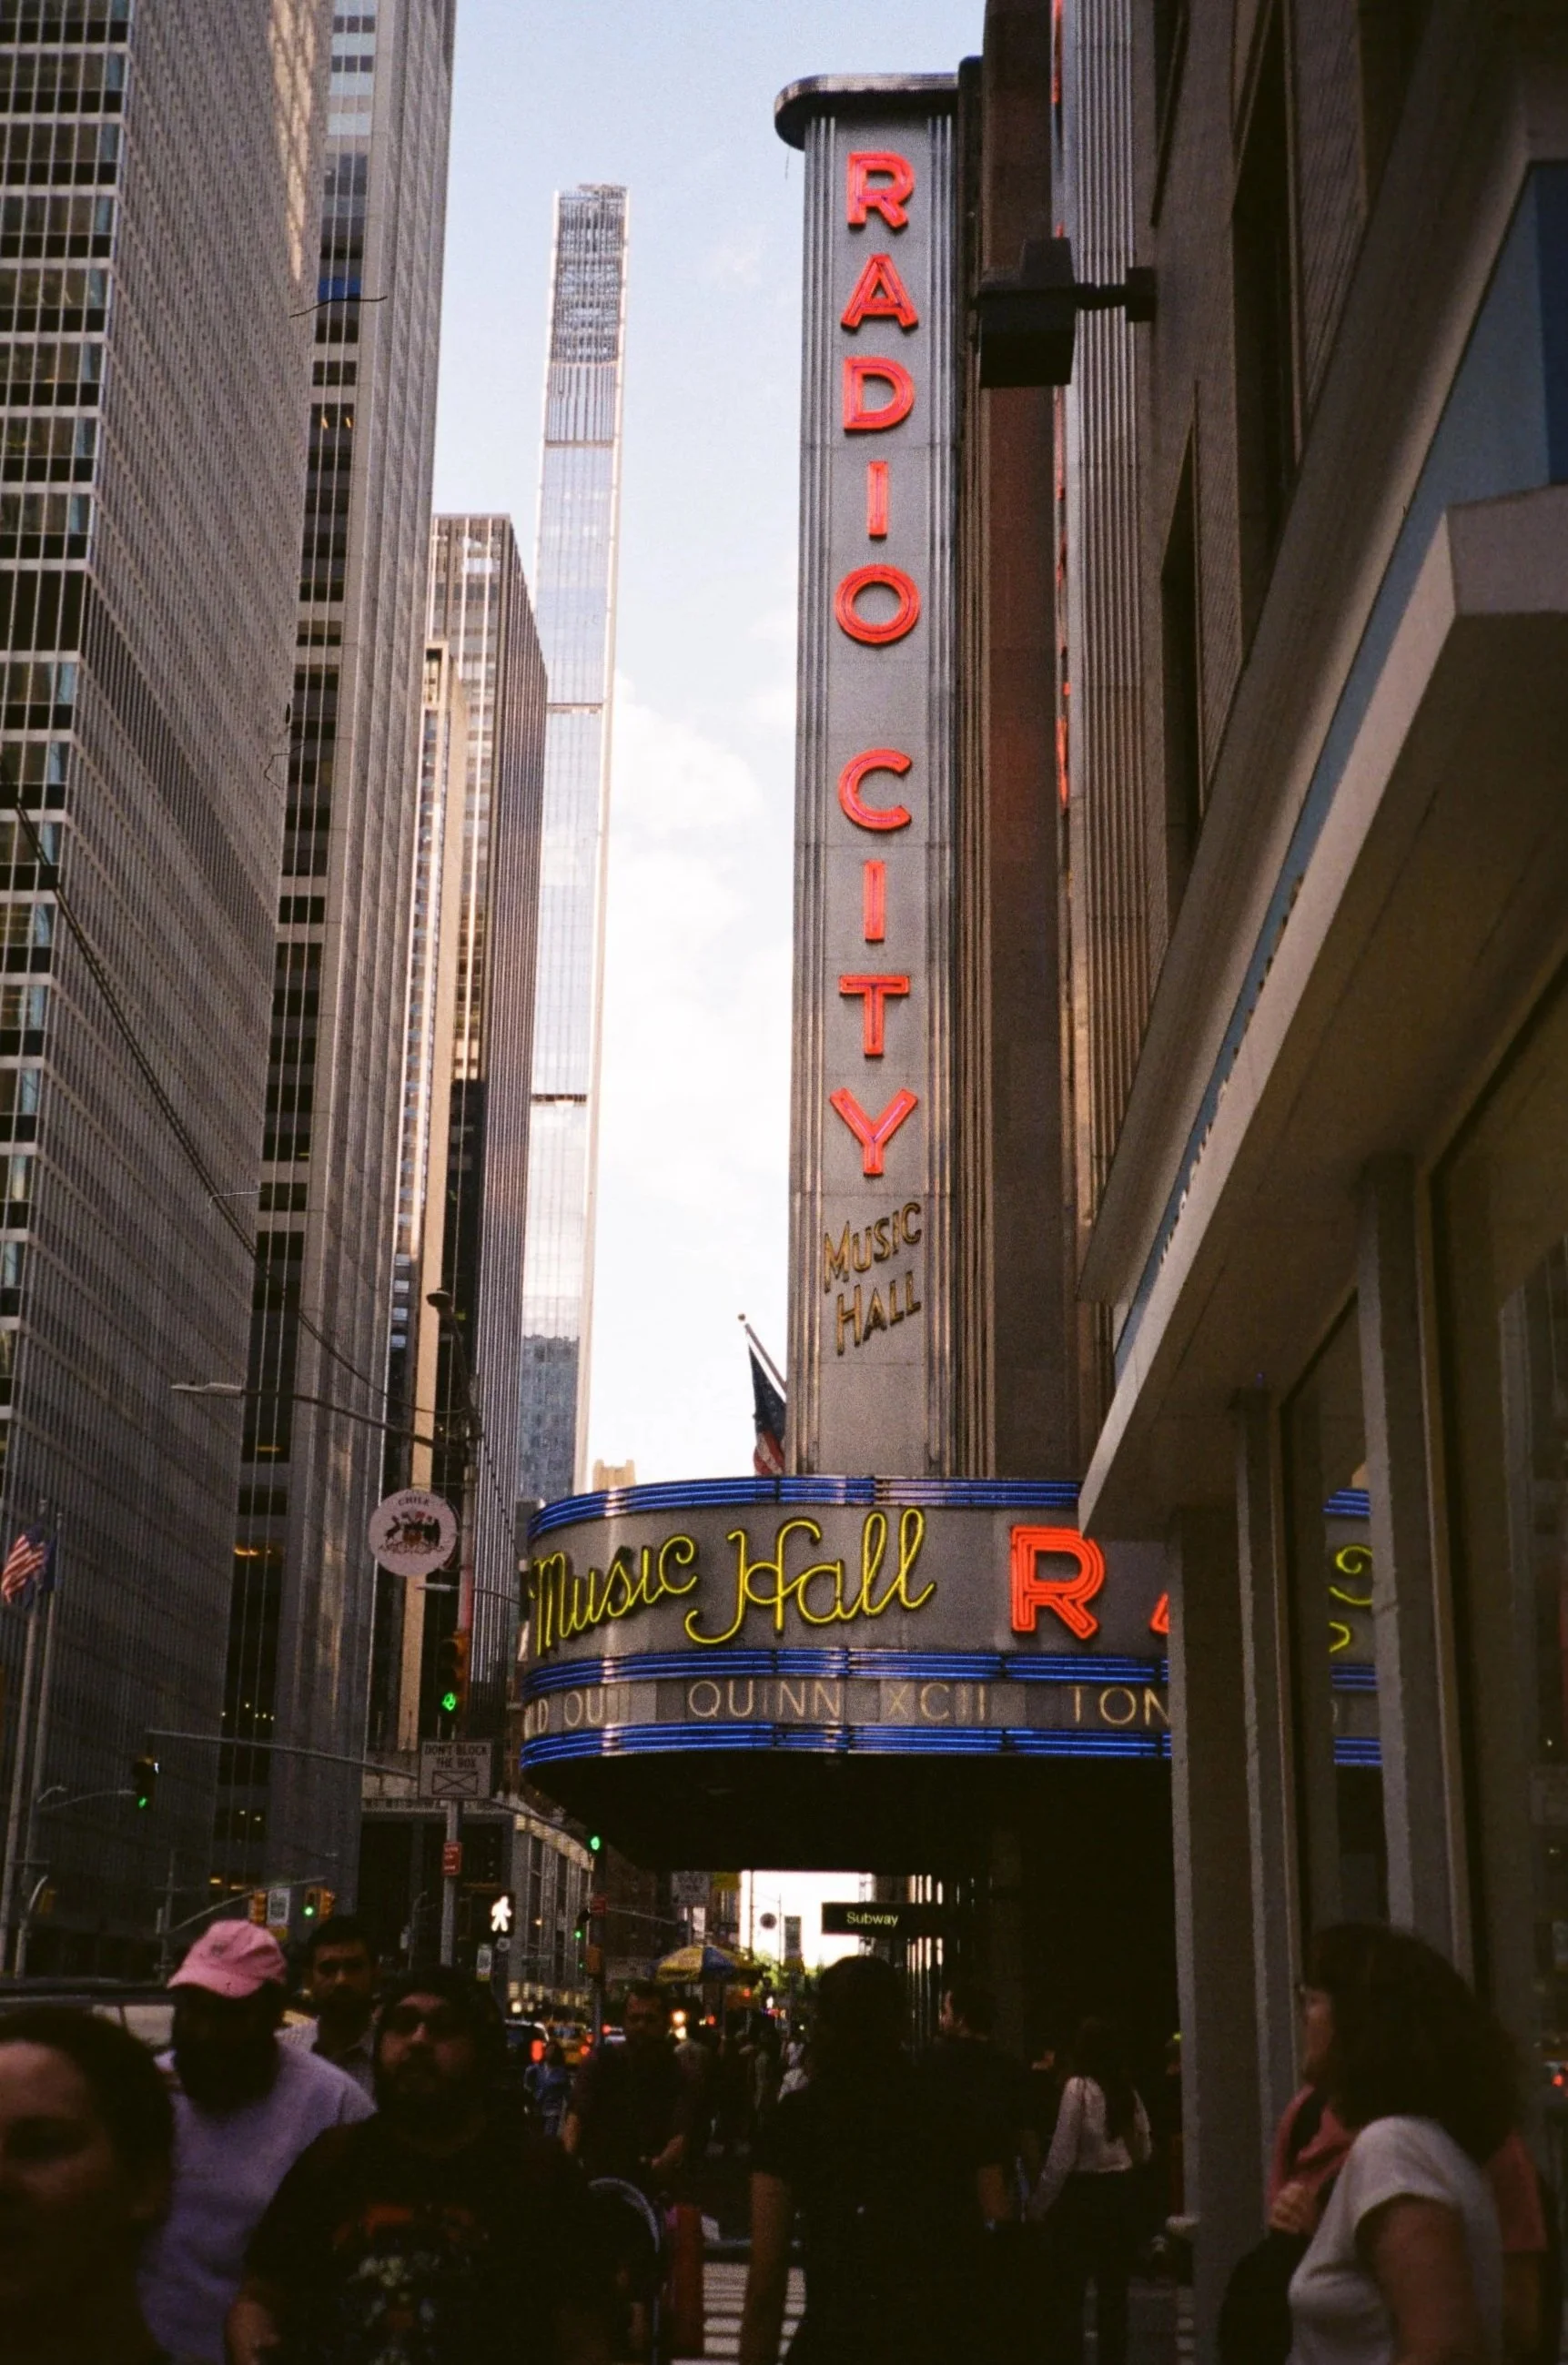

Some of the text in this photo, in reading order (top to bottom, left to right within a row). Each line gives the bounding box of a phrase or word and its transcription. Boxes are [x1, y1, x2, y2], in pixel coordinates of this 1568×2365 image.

[829, 151, 921, 1175] RADIO CITY
[824, 1201, 922, 1294] MUSIC
[835, 1270, 922, 1357] HALL
[529, 1507, 935, 1657] Music Hall
[689, 1680, 841, 1718] QUINN
[437, 1757, 476, 1768] THE BOX
[456, 1744, 487, 1756] BLOCK
[846, 1912, 898, 1927] Subway
